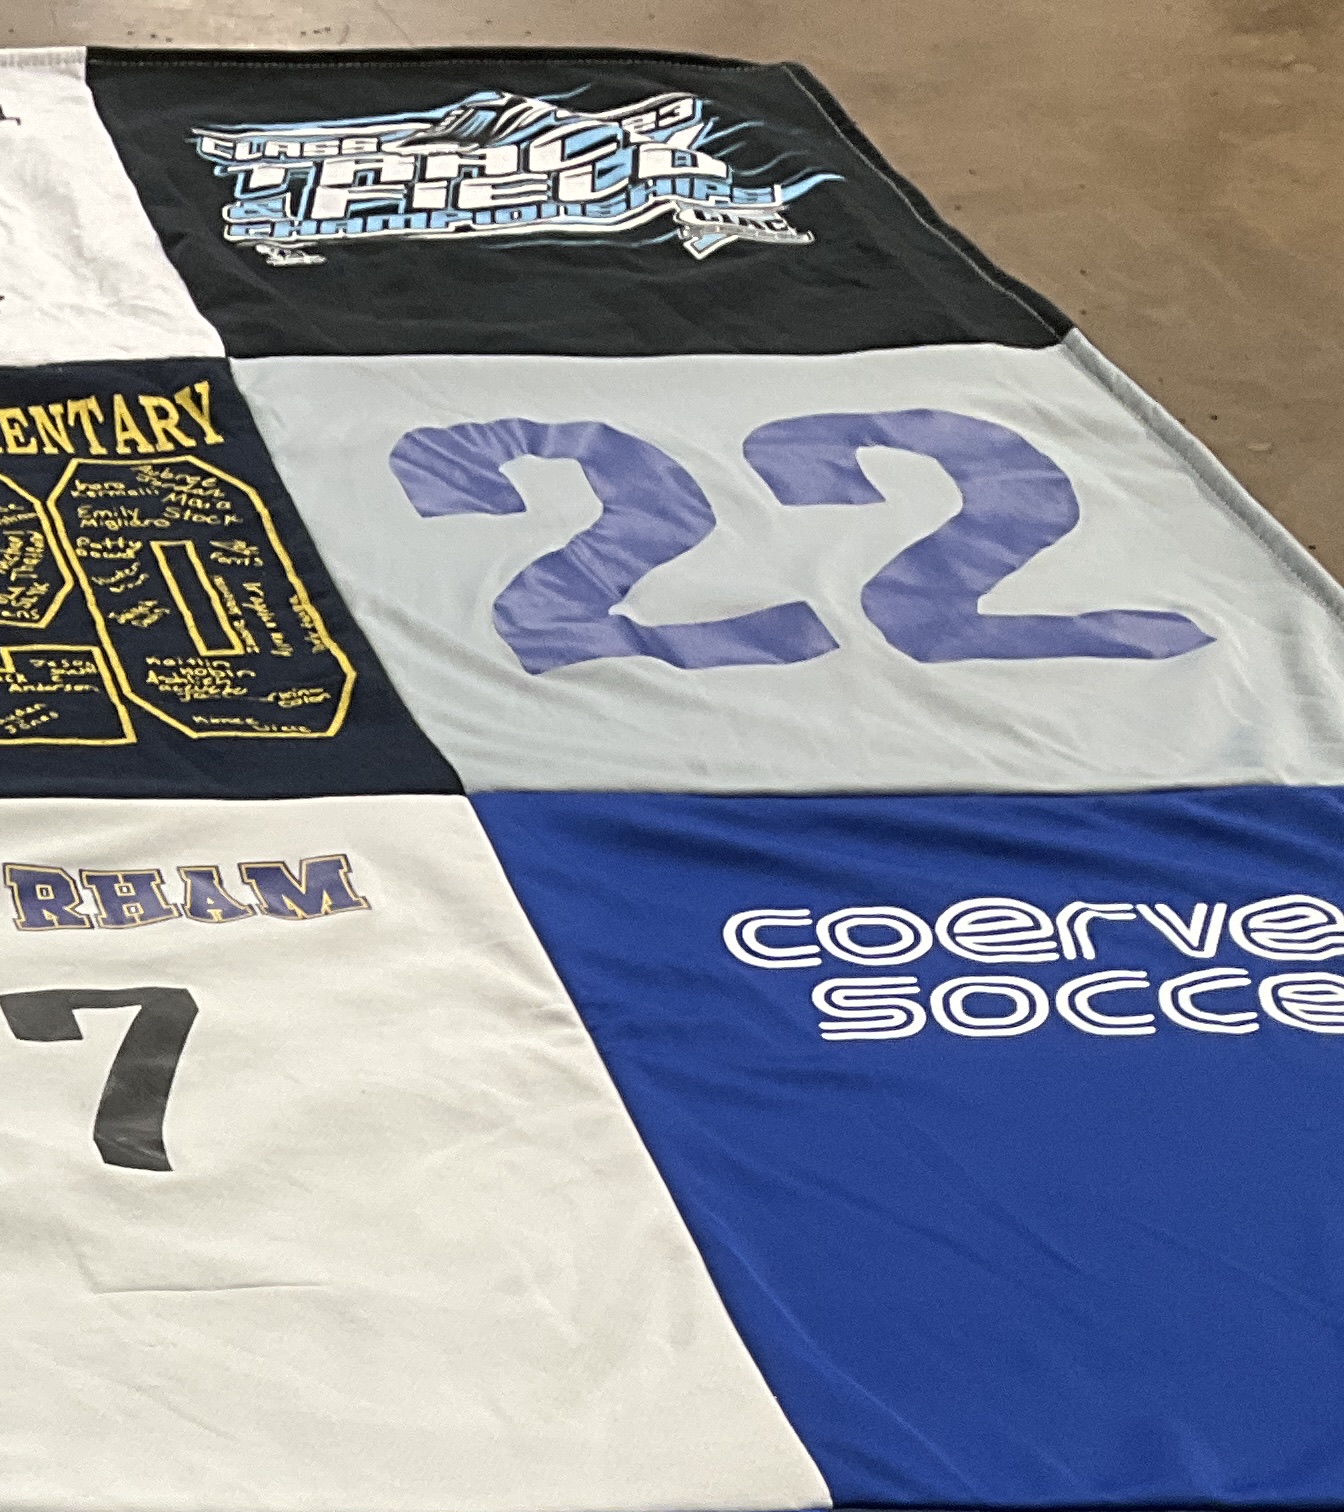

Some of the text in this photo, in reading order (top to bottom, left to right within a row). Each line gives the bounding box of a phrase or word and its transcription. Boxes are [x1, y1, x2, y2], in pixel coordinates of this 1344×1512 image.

[76, 503, 140, 521] Emily
[388, 408, 1218, 676] 22
[2, 853, 372, 933] RHAM
